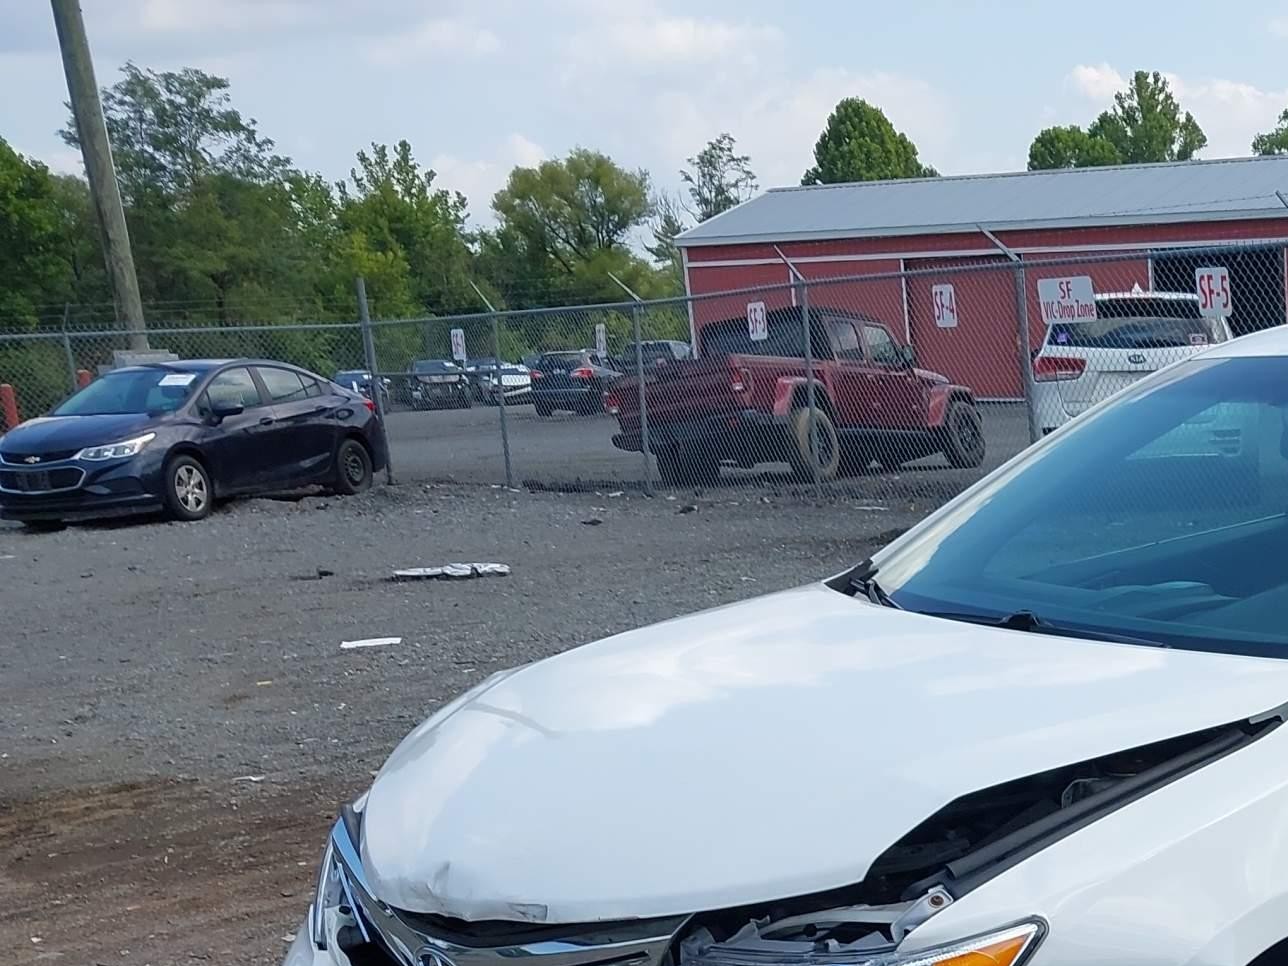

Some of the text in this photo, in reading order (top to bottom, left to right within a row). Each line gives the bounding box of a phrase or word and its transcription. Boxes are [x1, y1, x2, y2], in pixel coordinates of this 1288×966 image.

[1058, 281, 1073, 299] SF
[1199, 274, 1230, 309] SF-5
[934, 290, 956, 320] SF-4
[1075, 299, 1095, 318] Zone
